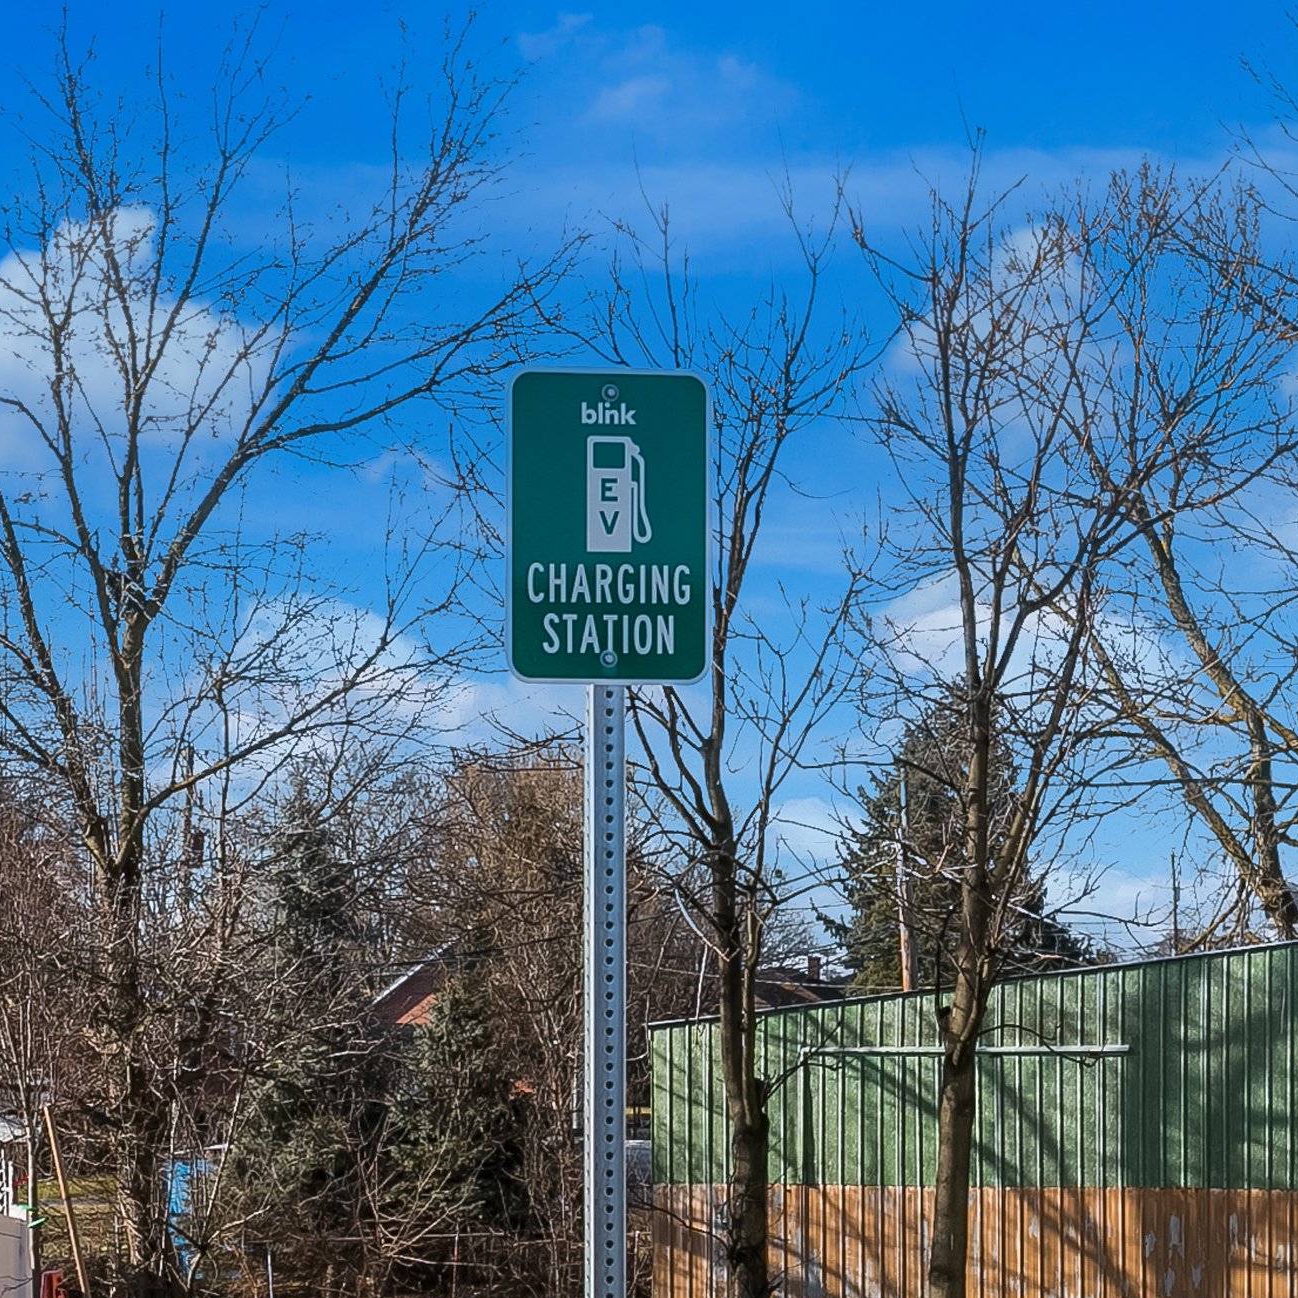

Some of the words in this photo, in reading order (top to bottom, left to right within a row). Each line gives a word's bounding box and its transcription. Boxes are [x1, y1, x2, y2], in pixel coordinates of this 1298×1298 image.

[581, 401, 637, 425] blink
[527, 562, 691, 605] CHARGING
[542, 613, 675, 655] STATION
